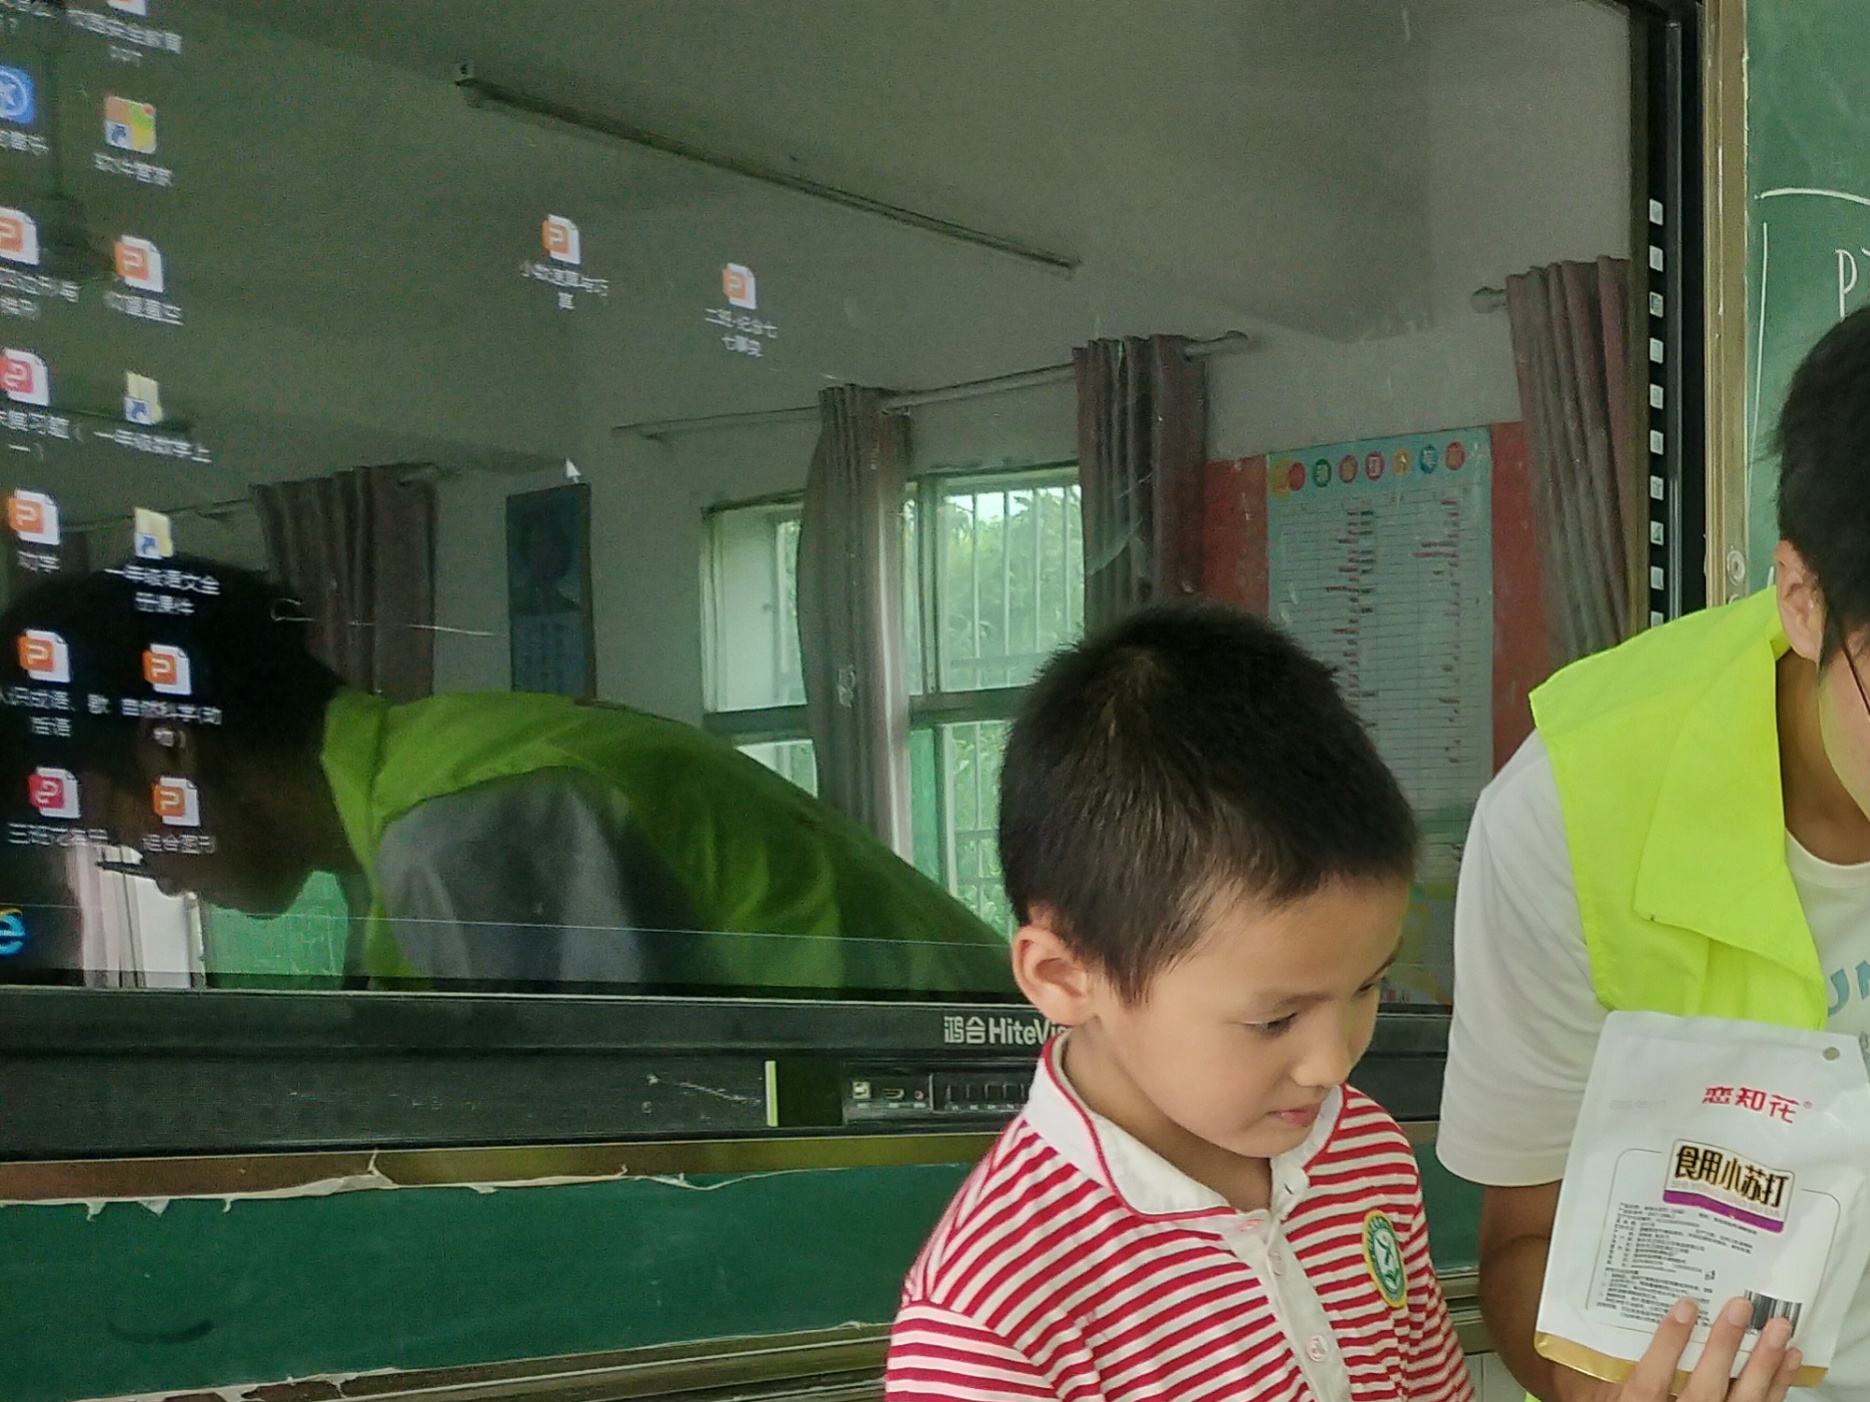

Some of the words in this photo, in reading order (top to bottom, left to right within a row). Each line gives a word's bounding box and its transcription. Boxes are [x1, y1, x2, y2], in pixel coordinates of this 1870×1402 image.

[1675, 1145, 1789, 1208] 食用小苏打
